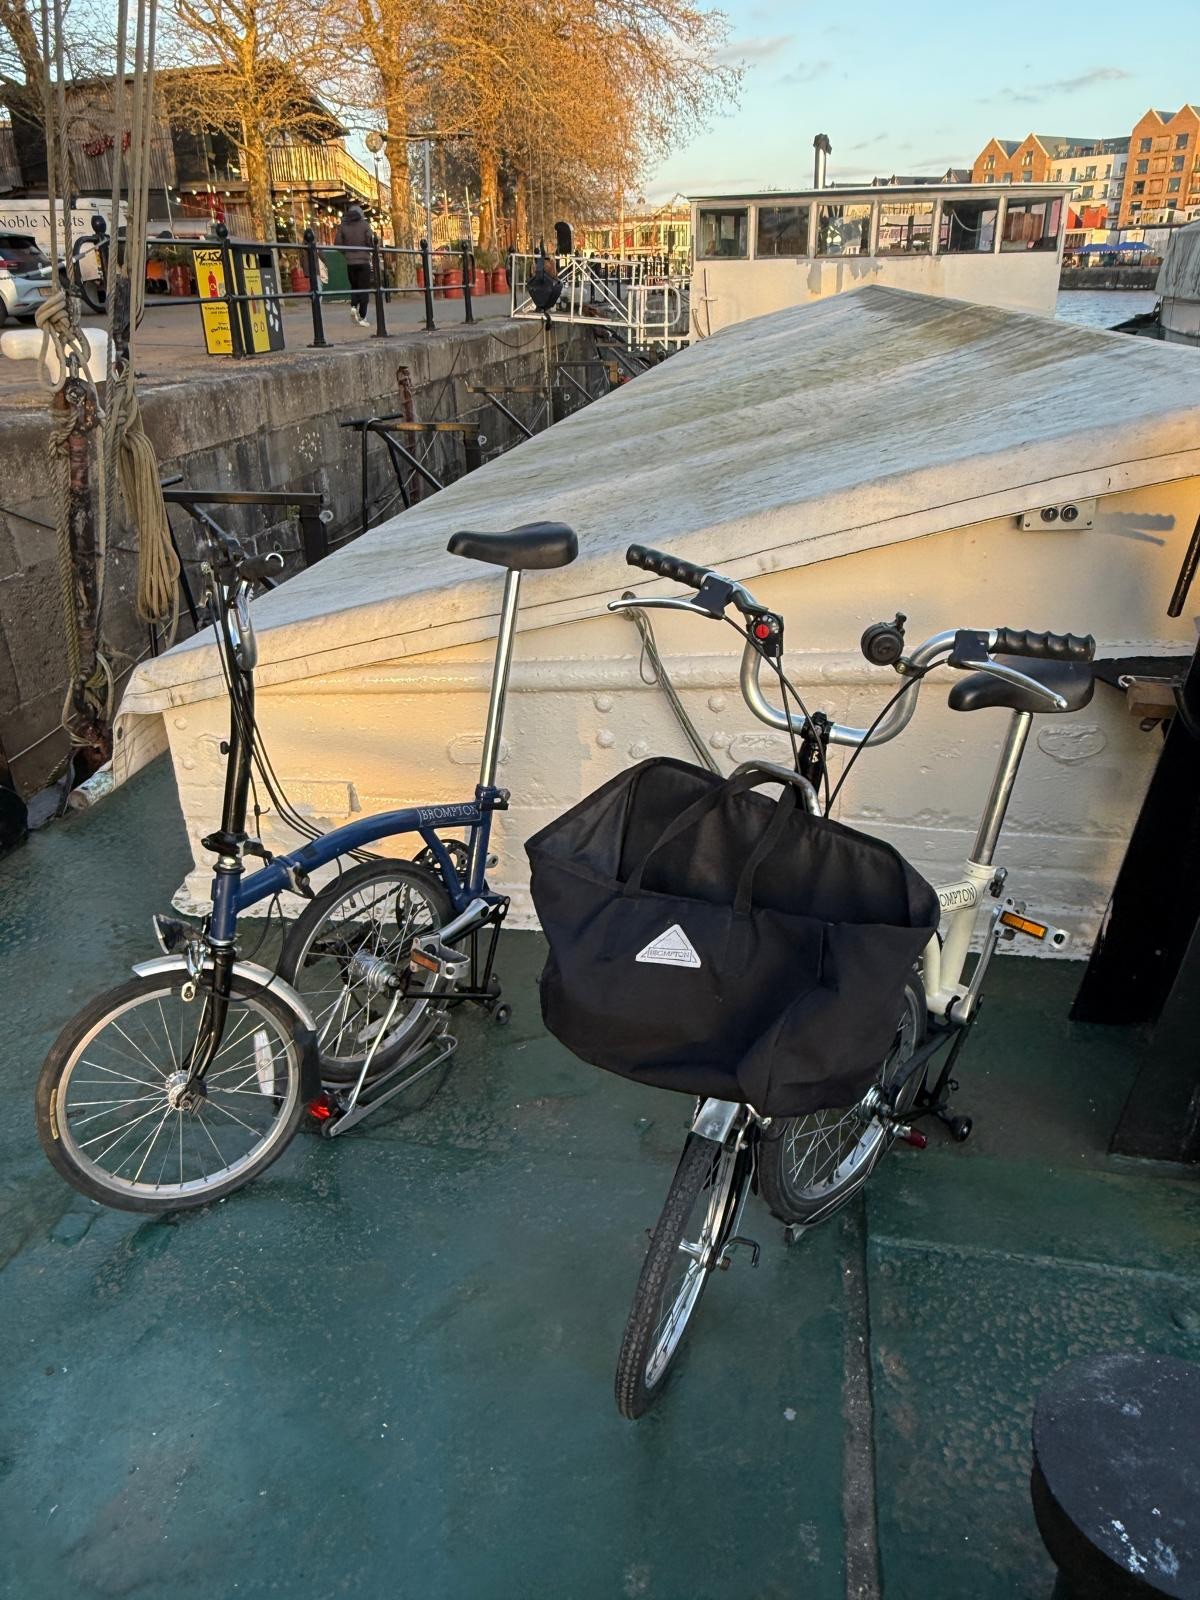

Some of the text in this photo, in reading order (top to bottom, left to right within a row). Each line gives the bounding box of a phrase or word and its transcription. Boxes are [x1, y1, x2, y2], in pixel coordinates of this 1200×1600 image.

[41, 215, 84, 228] Mats
[421, 804, 479, 820] BROMPTON
[939, 887, 975, 907] OMPTON
